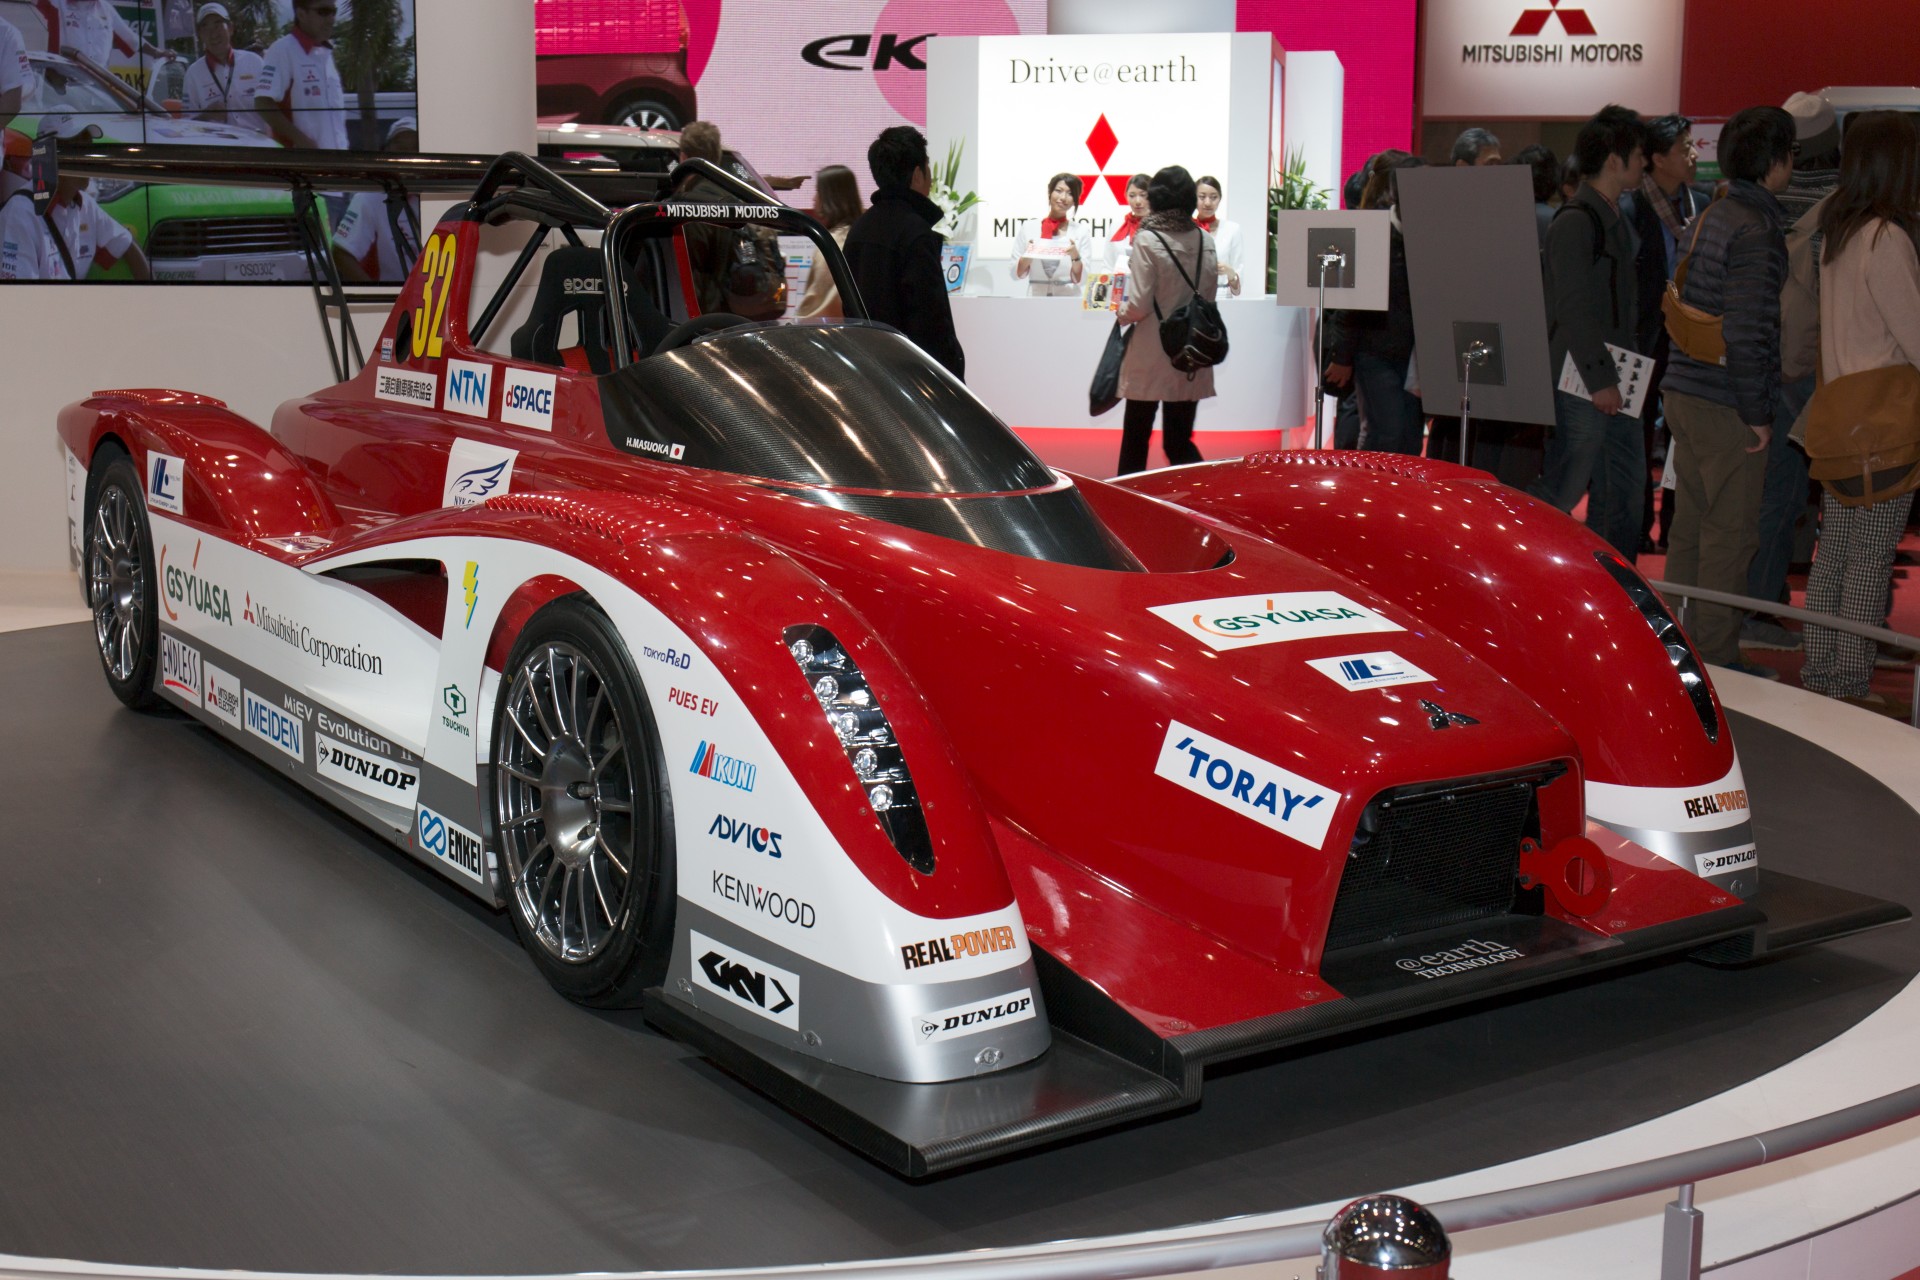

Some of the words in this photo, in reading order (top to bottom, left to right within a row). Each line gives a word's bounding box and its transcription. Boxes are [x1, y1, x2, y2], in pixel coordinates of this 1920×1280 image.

[1462, 44, 1562, 63] MITSUBISHI
[1570, 43, 1643, 63] MOTORS
[667, 203, 729, 218] MITSUBISHI
[735, 205, 779, 219] MOTORS
[412, 233, 457, 358] 32
[449, 368, 487, 408] NTN
[505, 384, 552, 415] dSPACE
[626, 436, 669, 455] H.MASUOKA
[256, 602, 299, 648] Mitsubishi
[301, 626, 383, 675] Corporation
[162, 635, 198, 690] ENDLESS
[217, 686, 239, 708] MITSUBISHI
[217, 698, 237, 717] ELECTRIC
[668, 687, 697, 712] PUES
[700, 698, 718, 717] EV
[248, 697, 300, 754] MEIDEN
[318, 714, 391, 755] Evolution
[442, 715, 470, 738] TSUCHIYA
[330, 747, 416, 791] DUNLOP
[448, 826, 482, 877] ENKEI
[708, 813, 782, 859] ADVICS
[713, 870, 815, 929] KENWOOD
[1395, 938, 1510, 971] @earth
[1414, 949, 1526, 979] TECHNOLOGY
[942, 997, 1030, 1031] DUNLOP
